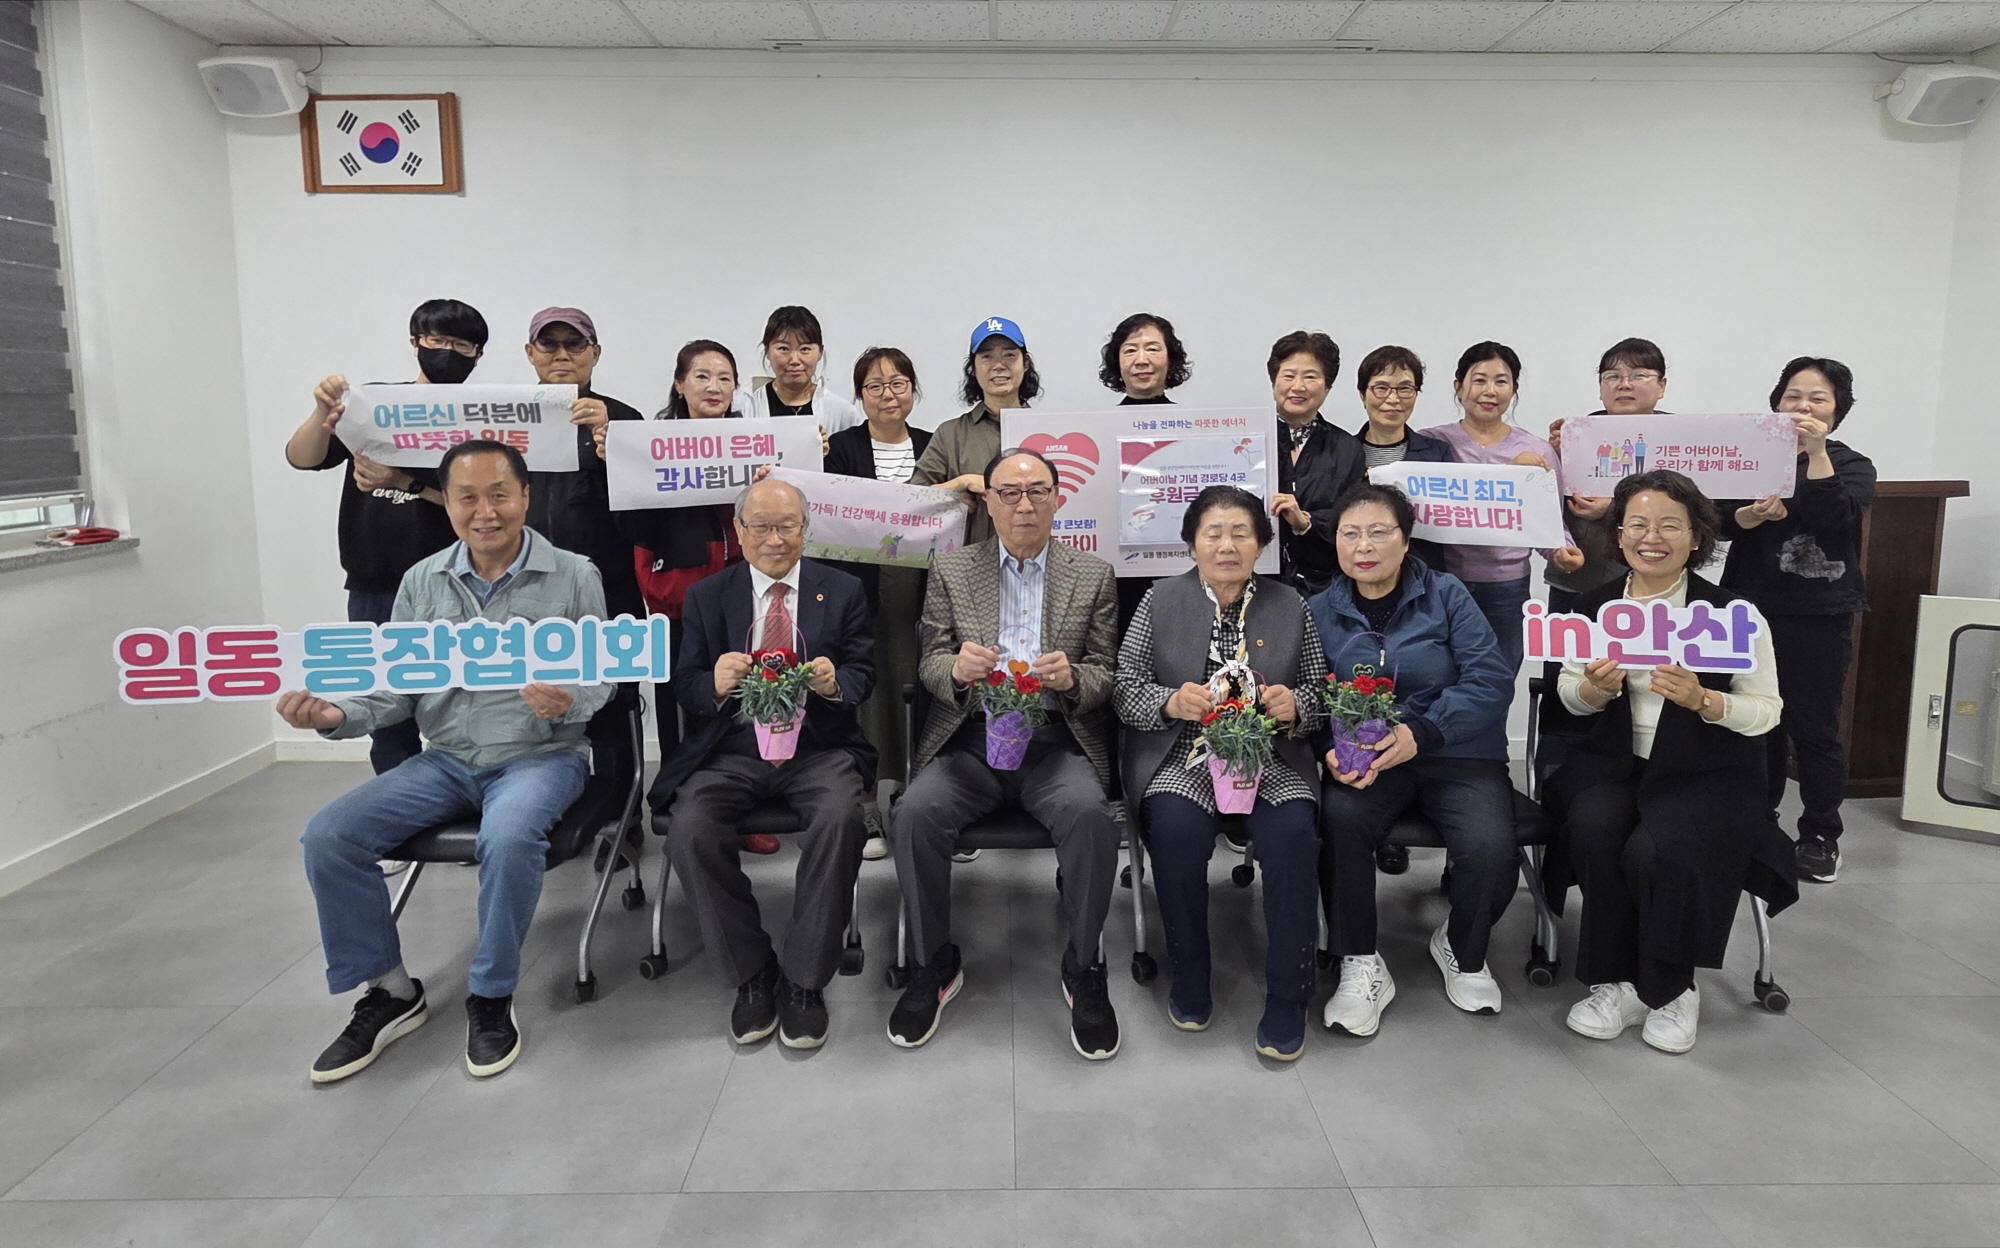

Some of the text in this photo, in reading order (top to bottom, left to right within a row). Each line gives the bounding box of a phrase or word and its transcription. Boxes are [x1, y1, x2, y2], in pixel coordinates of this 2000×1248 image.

[986, 318, 1003, 332] LA
[373, 402, 542, 428] 어르신 덕분에
[1133, 417, 1247, 430] 나눔을 전파하는 따뜻한 에너지
[650, 433, 784, 461] 어버이 은혜,
[1045, 444, 1069, 452] ANSAN
[1655, 445, 1743, 458] 기쁜 어버이날,
[1655, 459, 1760, 471] 우리가 함께 해요!
[1140, 472, 1247, 486] 어버이날 기념 경로당 4곳
[1407, 476, 1524, 507] 어르신 최고,
[841, 506, 887, 523] 건강백세
[889, 512, 944, 529] 응원합니다
[1414, 503, 1523, 531] 사랑합니다!
[1064, 519, 1097, 530] 큰보람!
[1142, 551, 1154, 559] 일동
[118, 617, 668, 700] 일동 통장협의회
